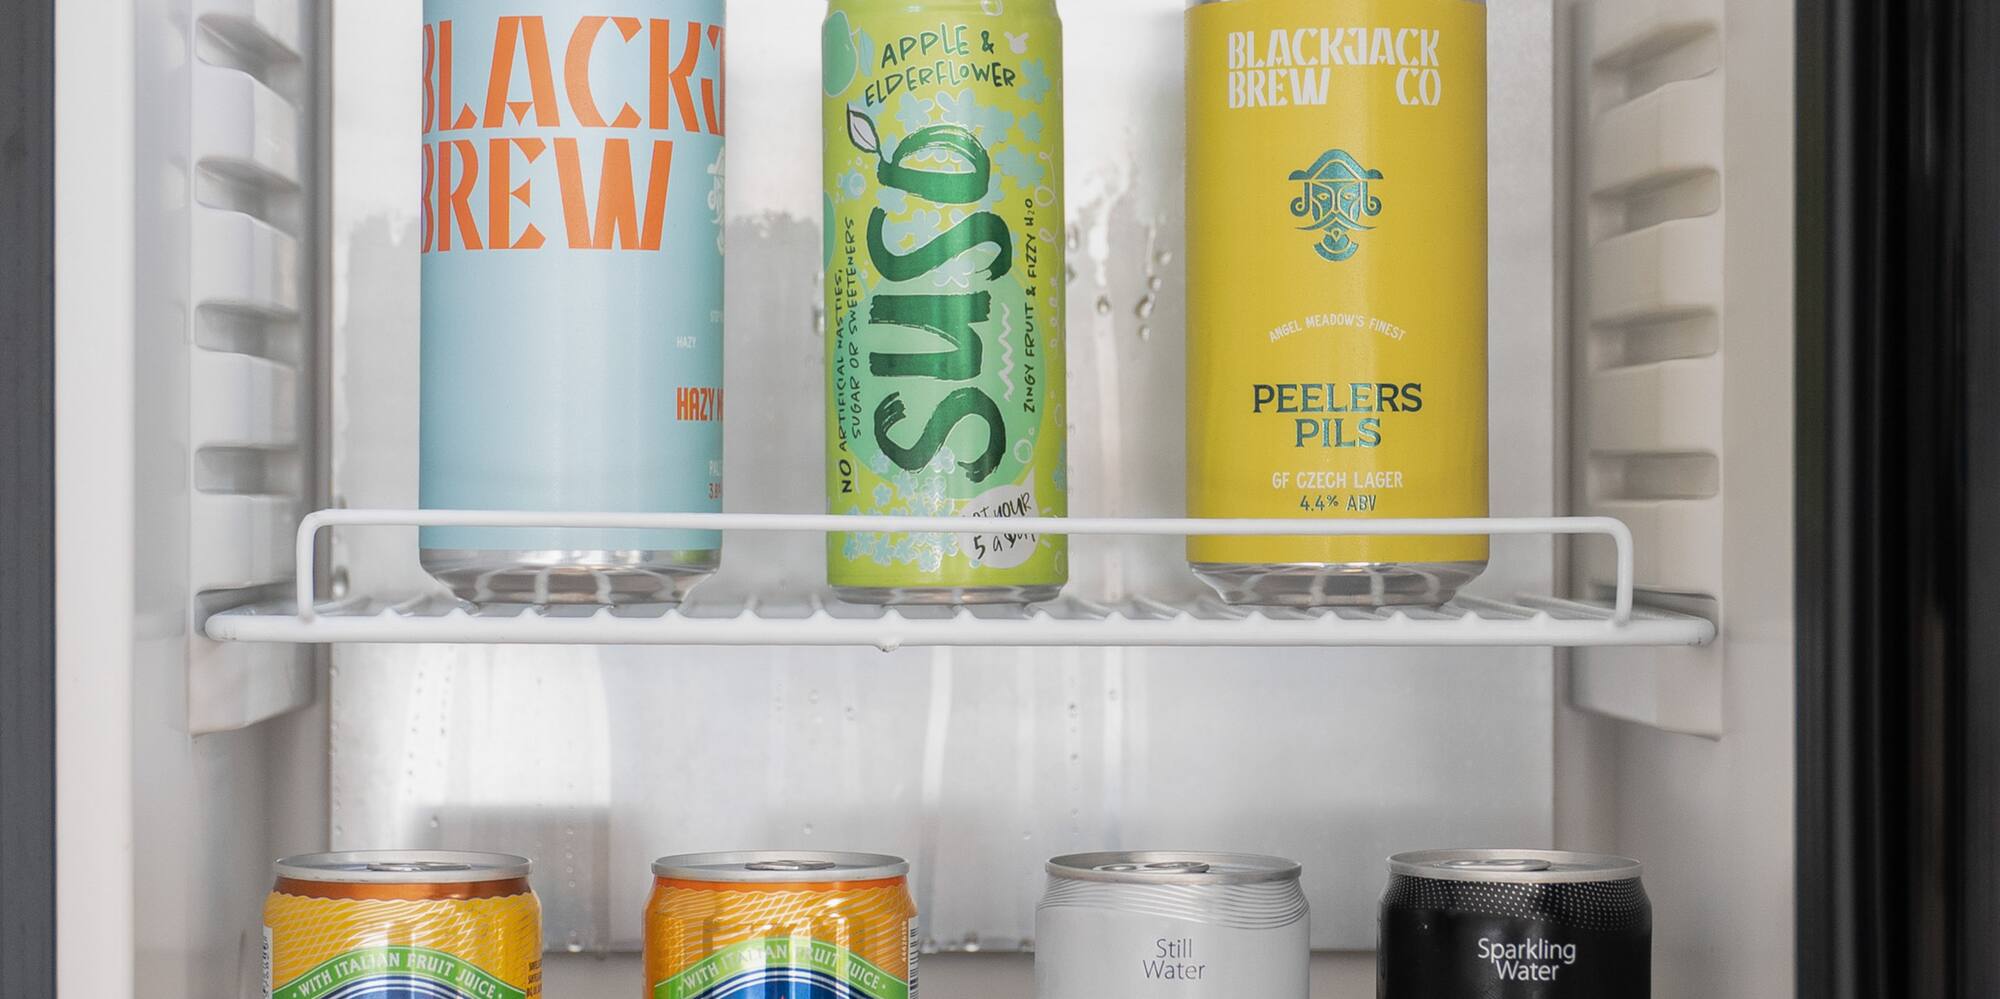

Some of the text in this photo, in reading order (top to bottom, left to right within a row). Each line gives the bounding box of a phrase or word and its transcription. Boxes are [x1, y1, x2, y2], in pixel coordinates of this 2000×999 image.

[881, 23, 994, 69] APPLE &
[1228, 27, 1440, 70] BLACKJACK
[864, 60, 1016, 108] ELDERFLOWER
[1228, 67, 1441, 109] BREW CO
[1025, 233, 1037, 279] FIZZY
[1025, 284, 1037, 297] &
[845, 216, 862, 439] SUGAR OR SWEETENERS
[1024, 302, 1035, 357] FRUIT
[1268, 312, 1407, 343] ANGEL MEADOW'S FINEST
[834, 269, 853, 493] NO ARTIFICIAL NASTIES,
[1023, 363, 1036, 413] ZINGY
[676, 386, 715, 421] HAZY
[1253, 382, 1424, 414] PEELERS
[1295, 417, 1382, 448] PILS
[1272, 471, 1404, 489] GF CZECH LAGER
[1300, 494, 1377, 513] 4.4% ABV
[973, 534, 986, 560] 5
[1156, 938, 1192, 958] Still
[1477, 937, 1577, 965] Sparkling
[298, 970, 333, 998] WITH
[334, 952, 401, 978] ITALIAN
[407, 952, 455, 978] FRUIT
[455, 968, 497, 999] JUICE
[682, 961, 719, 990] WITH
[1142, 959, 1206, 980] Water
[1495, 959, 1560, 981] Water
